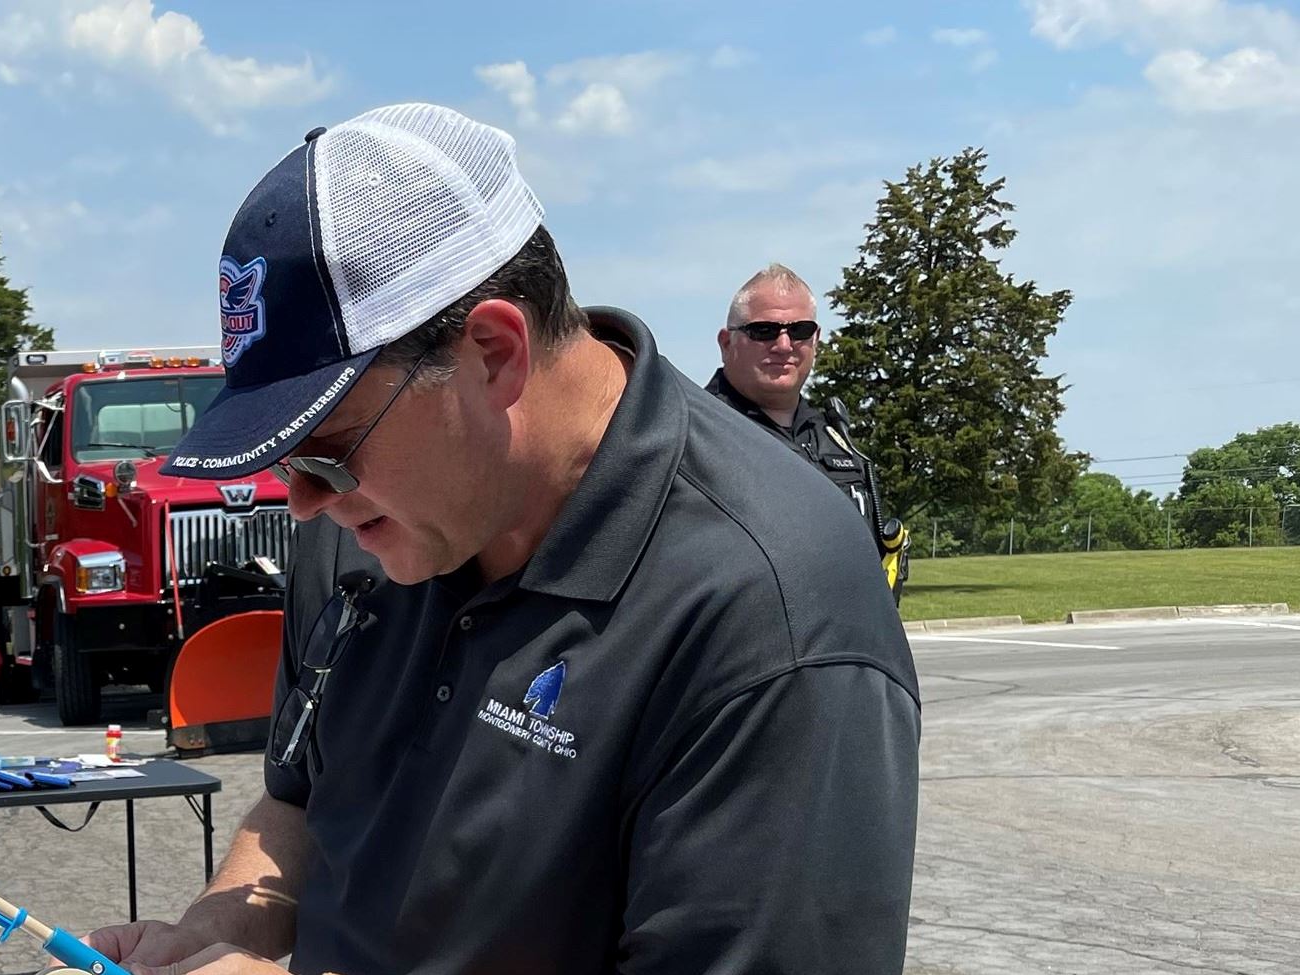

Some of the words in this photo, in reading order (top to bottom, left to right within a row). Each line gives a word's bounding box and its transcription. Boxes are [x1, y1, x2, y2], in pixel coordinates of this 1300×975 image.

[202, 438, 277, 469] COMMUNITY
[277, 366, 356, 441] PARTNERSHIPS
[477, 709, 531, 740] MONTGOMERY
[554, 744, 577, 759] OHIO
[486, 699, 526, 726] MIAMI
[528, 717, 575, 745] TOWNSHIP
